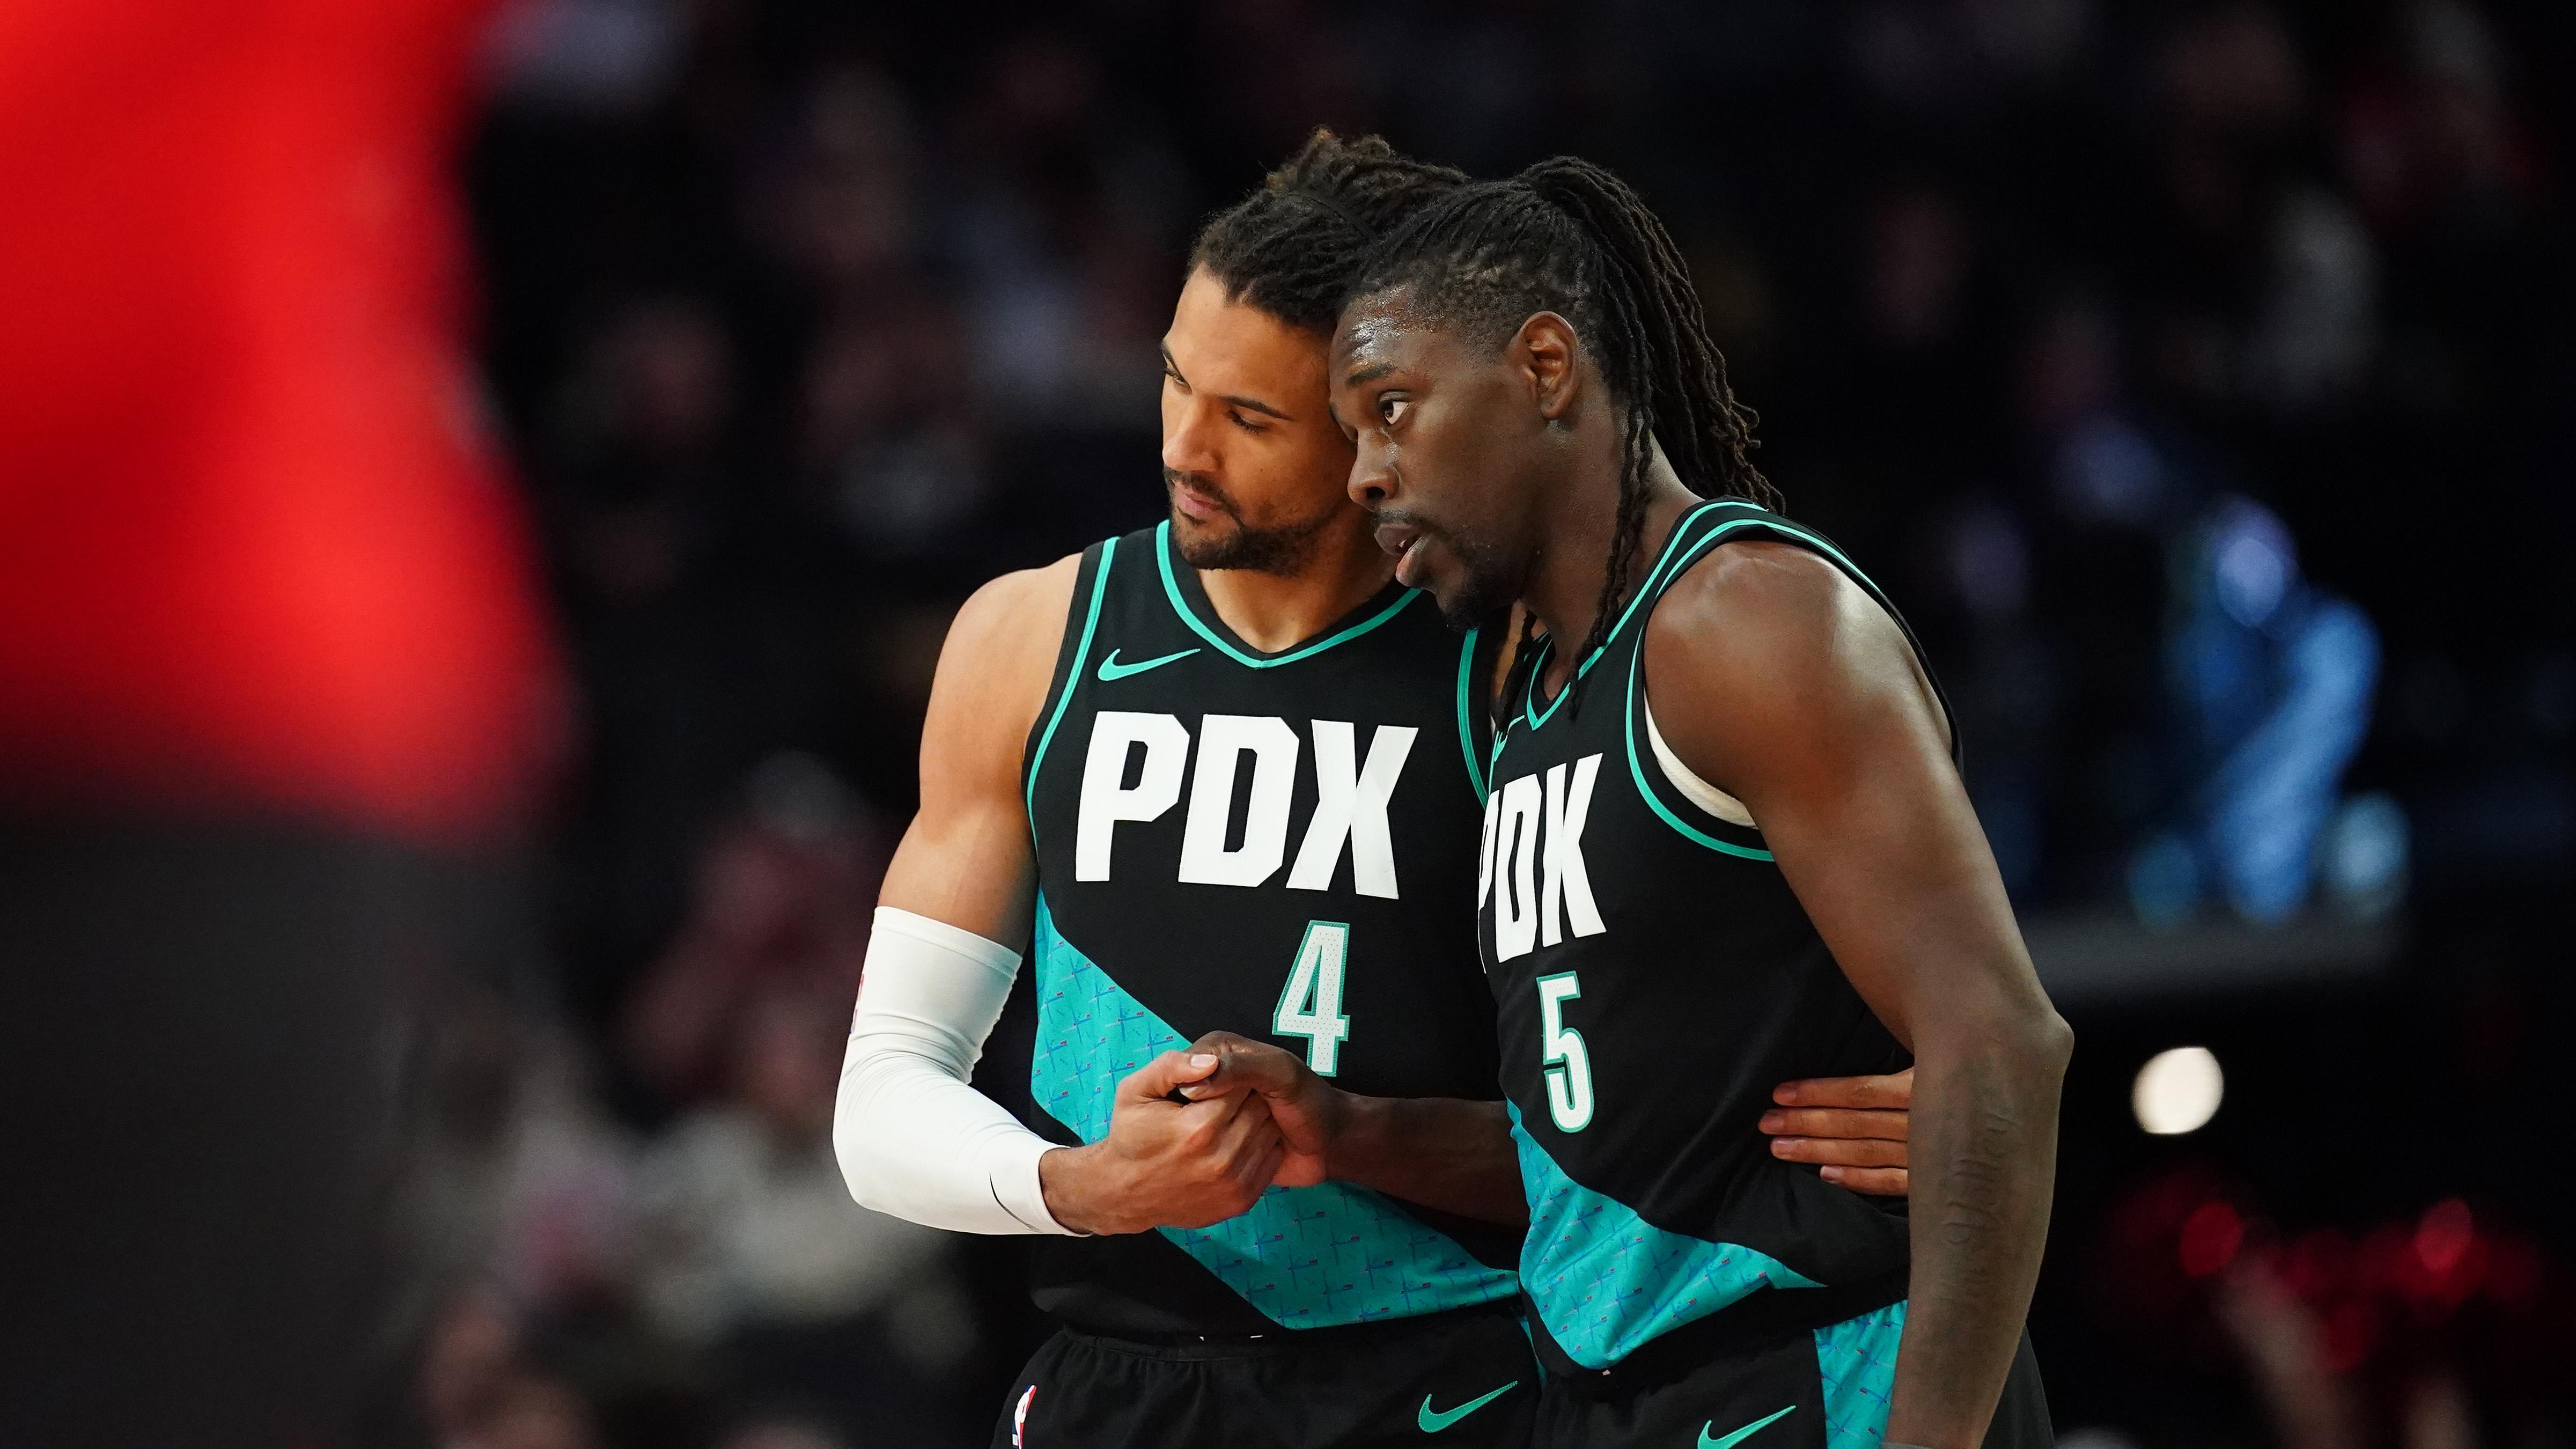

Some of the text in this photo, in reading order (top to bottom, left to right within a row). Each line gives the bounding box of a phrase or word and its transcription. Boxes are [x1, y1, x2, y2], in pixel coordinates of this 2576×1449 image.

[1075, 711, 1419, 900] PDX
[1272, 920, 1350, 1077] 4
[1536, 970, 1594, 1133] 5
